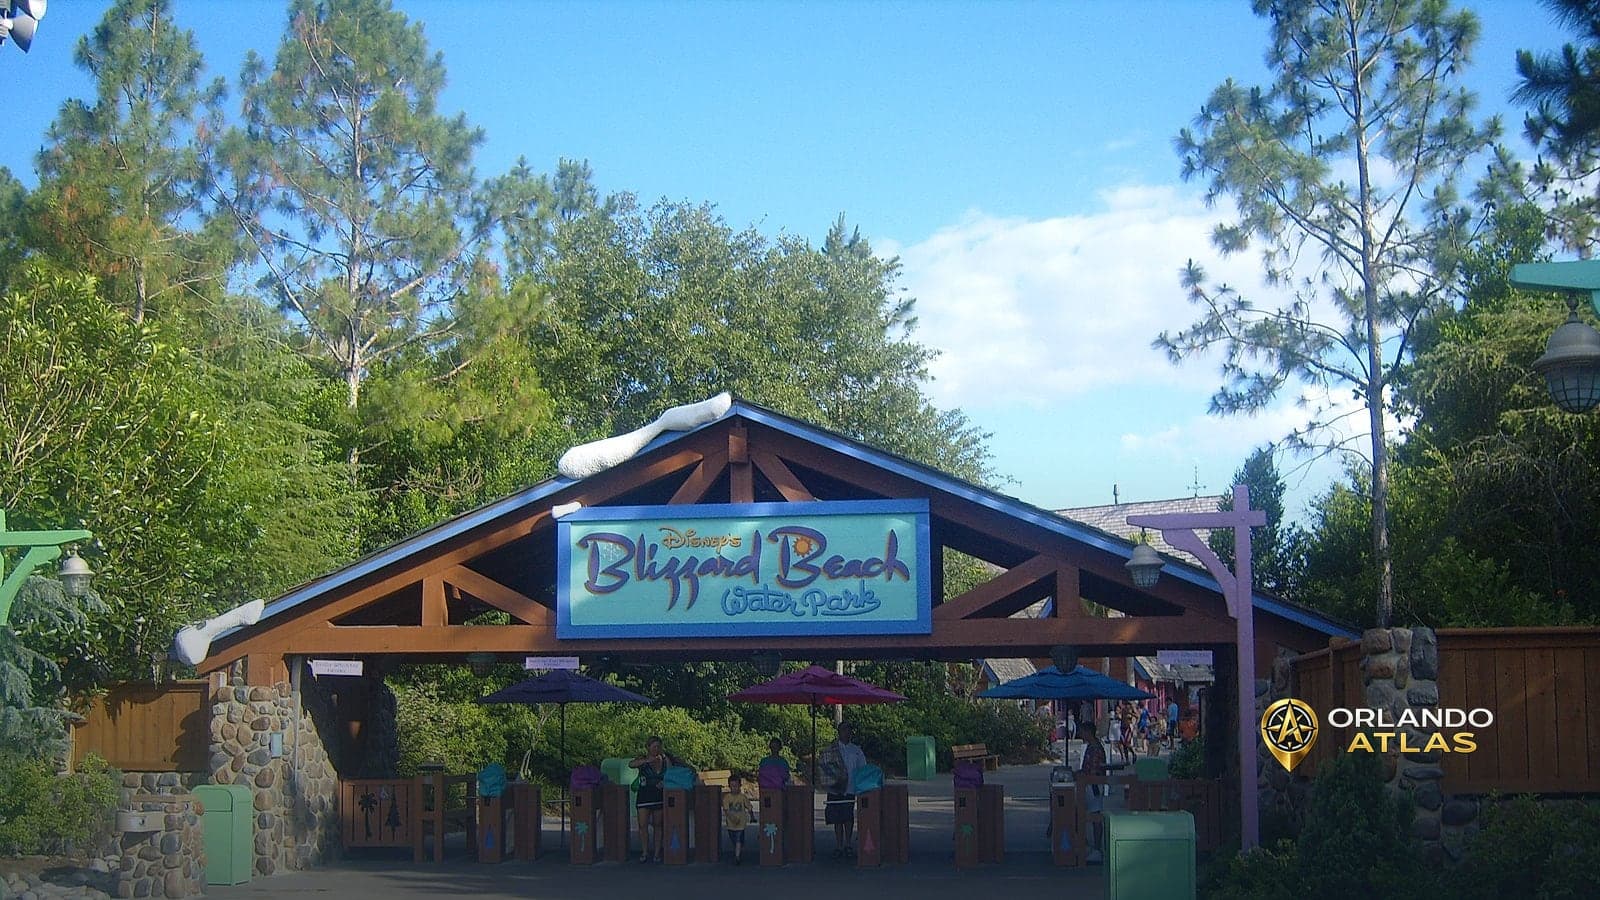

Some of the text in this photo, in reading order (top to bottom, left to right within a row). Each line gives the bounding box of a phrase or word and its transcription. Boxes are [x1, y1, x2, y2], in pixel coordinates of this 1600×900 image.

[576, 525, 911, 612] Blizzard Beach
[720, 580, 881, 617] Water Park
